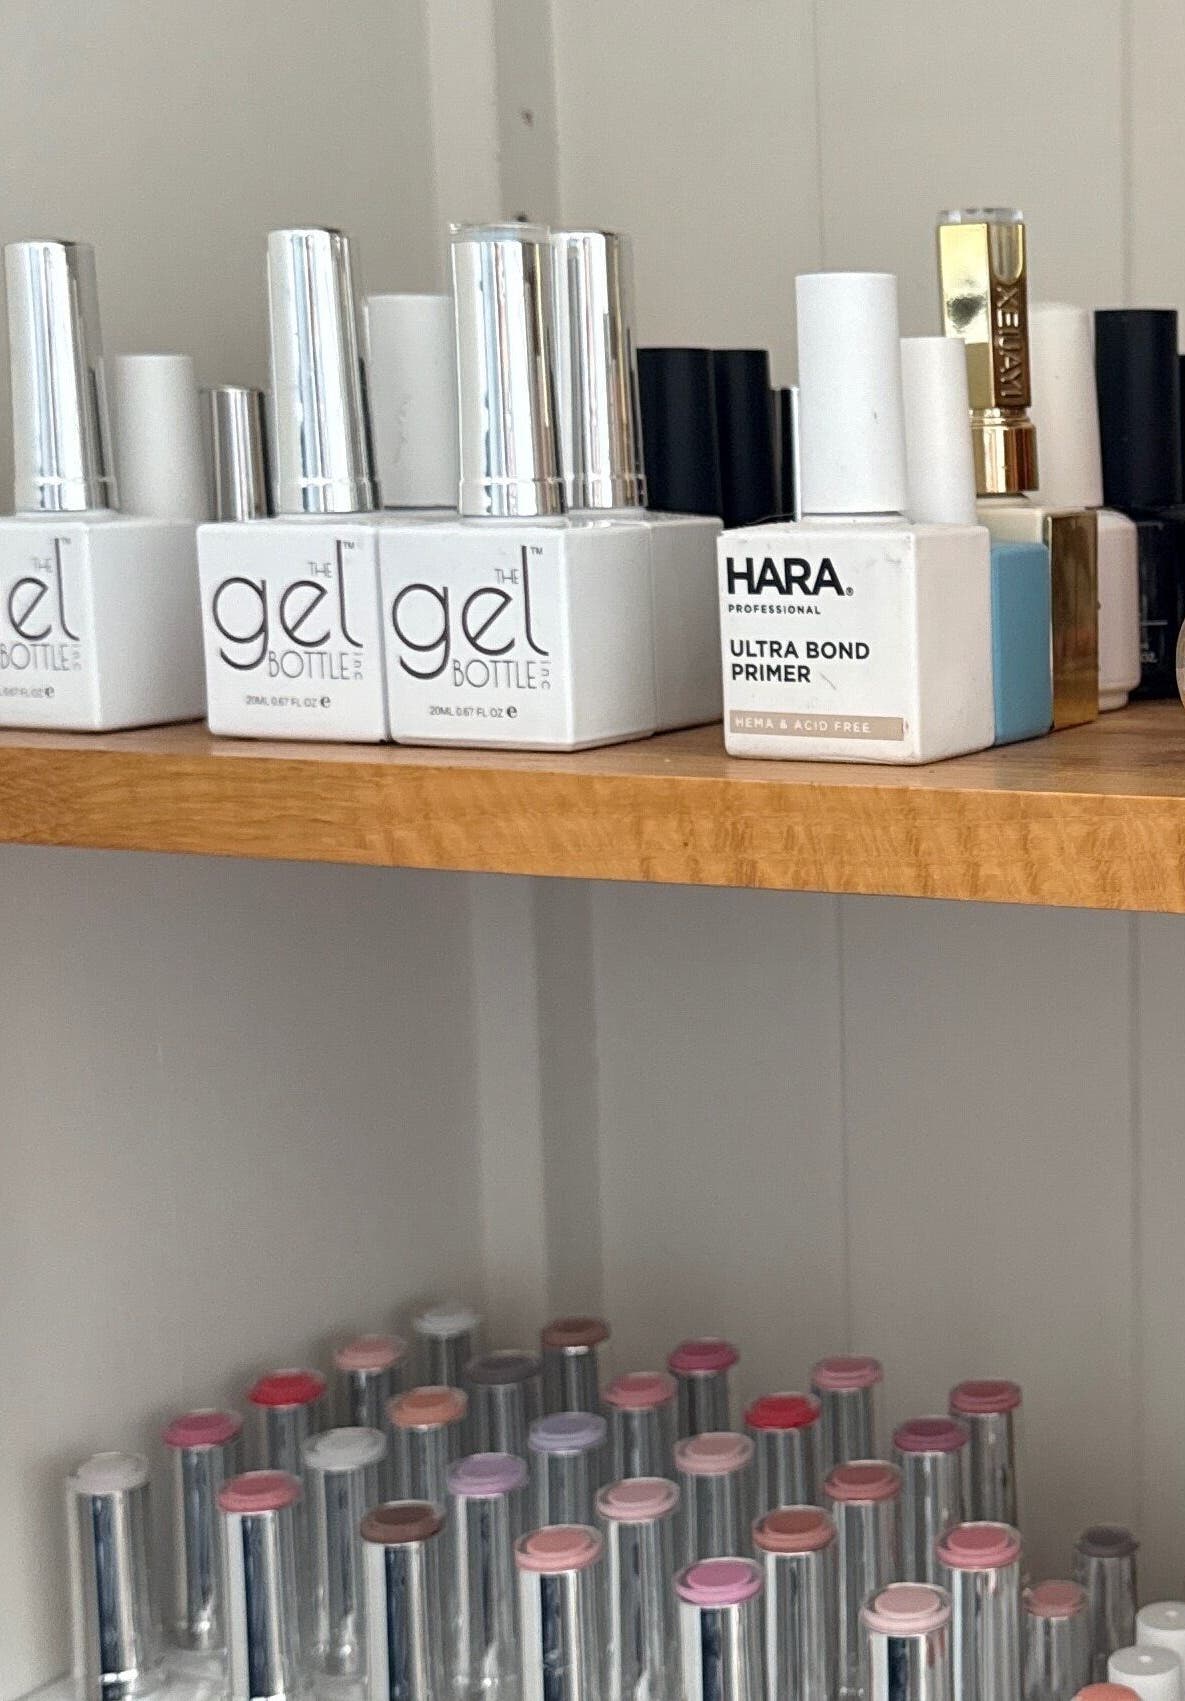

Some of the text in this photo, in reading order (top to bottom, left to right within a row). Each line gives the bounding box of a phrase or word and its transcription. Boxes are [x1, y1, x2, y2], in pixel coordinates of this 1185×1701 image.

[307, 561, 332, 578] THE
[494, 568, 519, 585] THE
[7, 538, 81, 641] el
[212, 540, 363, 671] gel
[392, 545, 549, 680] gel
[728, 603, 822, 615] PROFESSIONAL
[730, 639, 870, 661] ULTRA BOND
[268, 650, 349, 680] BOTTLE
[452, 659, 536, 690] BOTTLE
[732, 663, 811, 684] PRIMER
[429, 705, 454, 717] 20ML
[477, 708, 487, 717] FL
[490, 708, 503, 718] OZ
[735, 717, 871, 734] HEMA & ACID FREE
